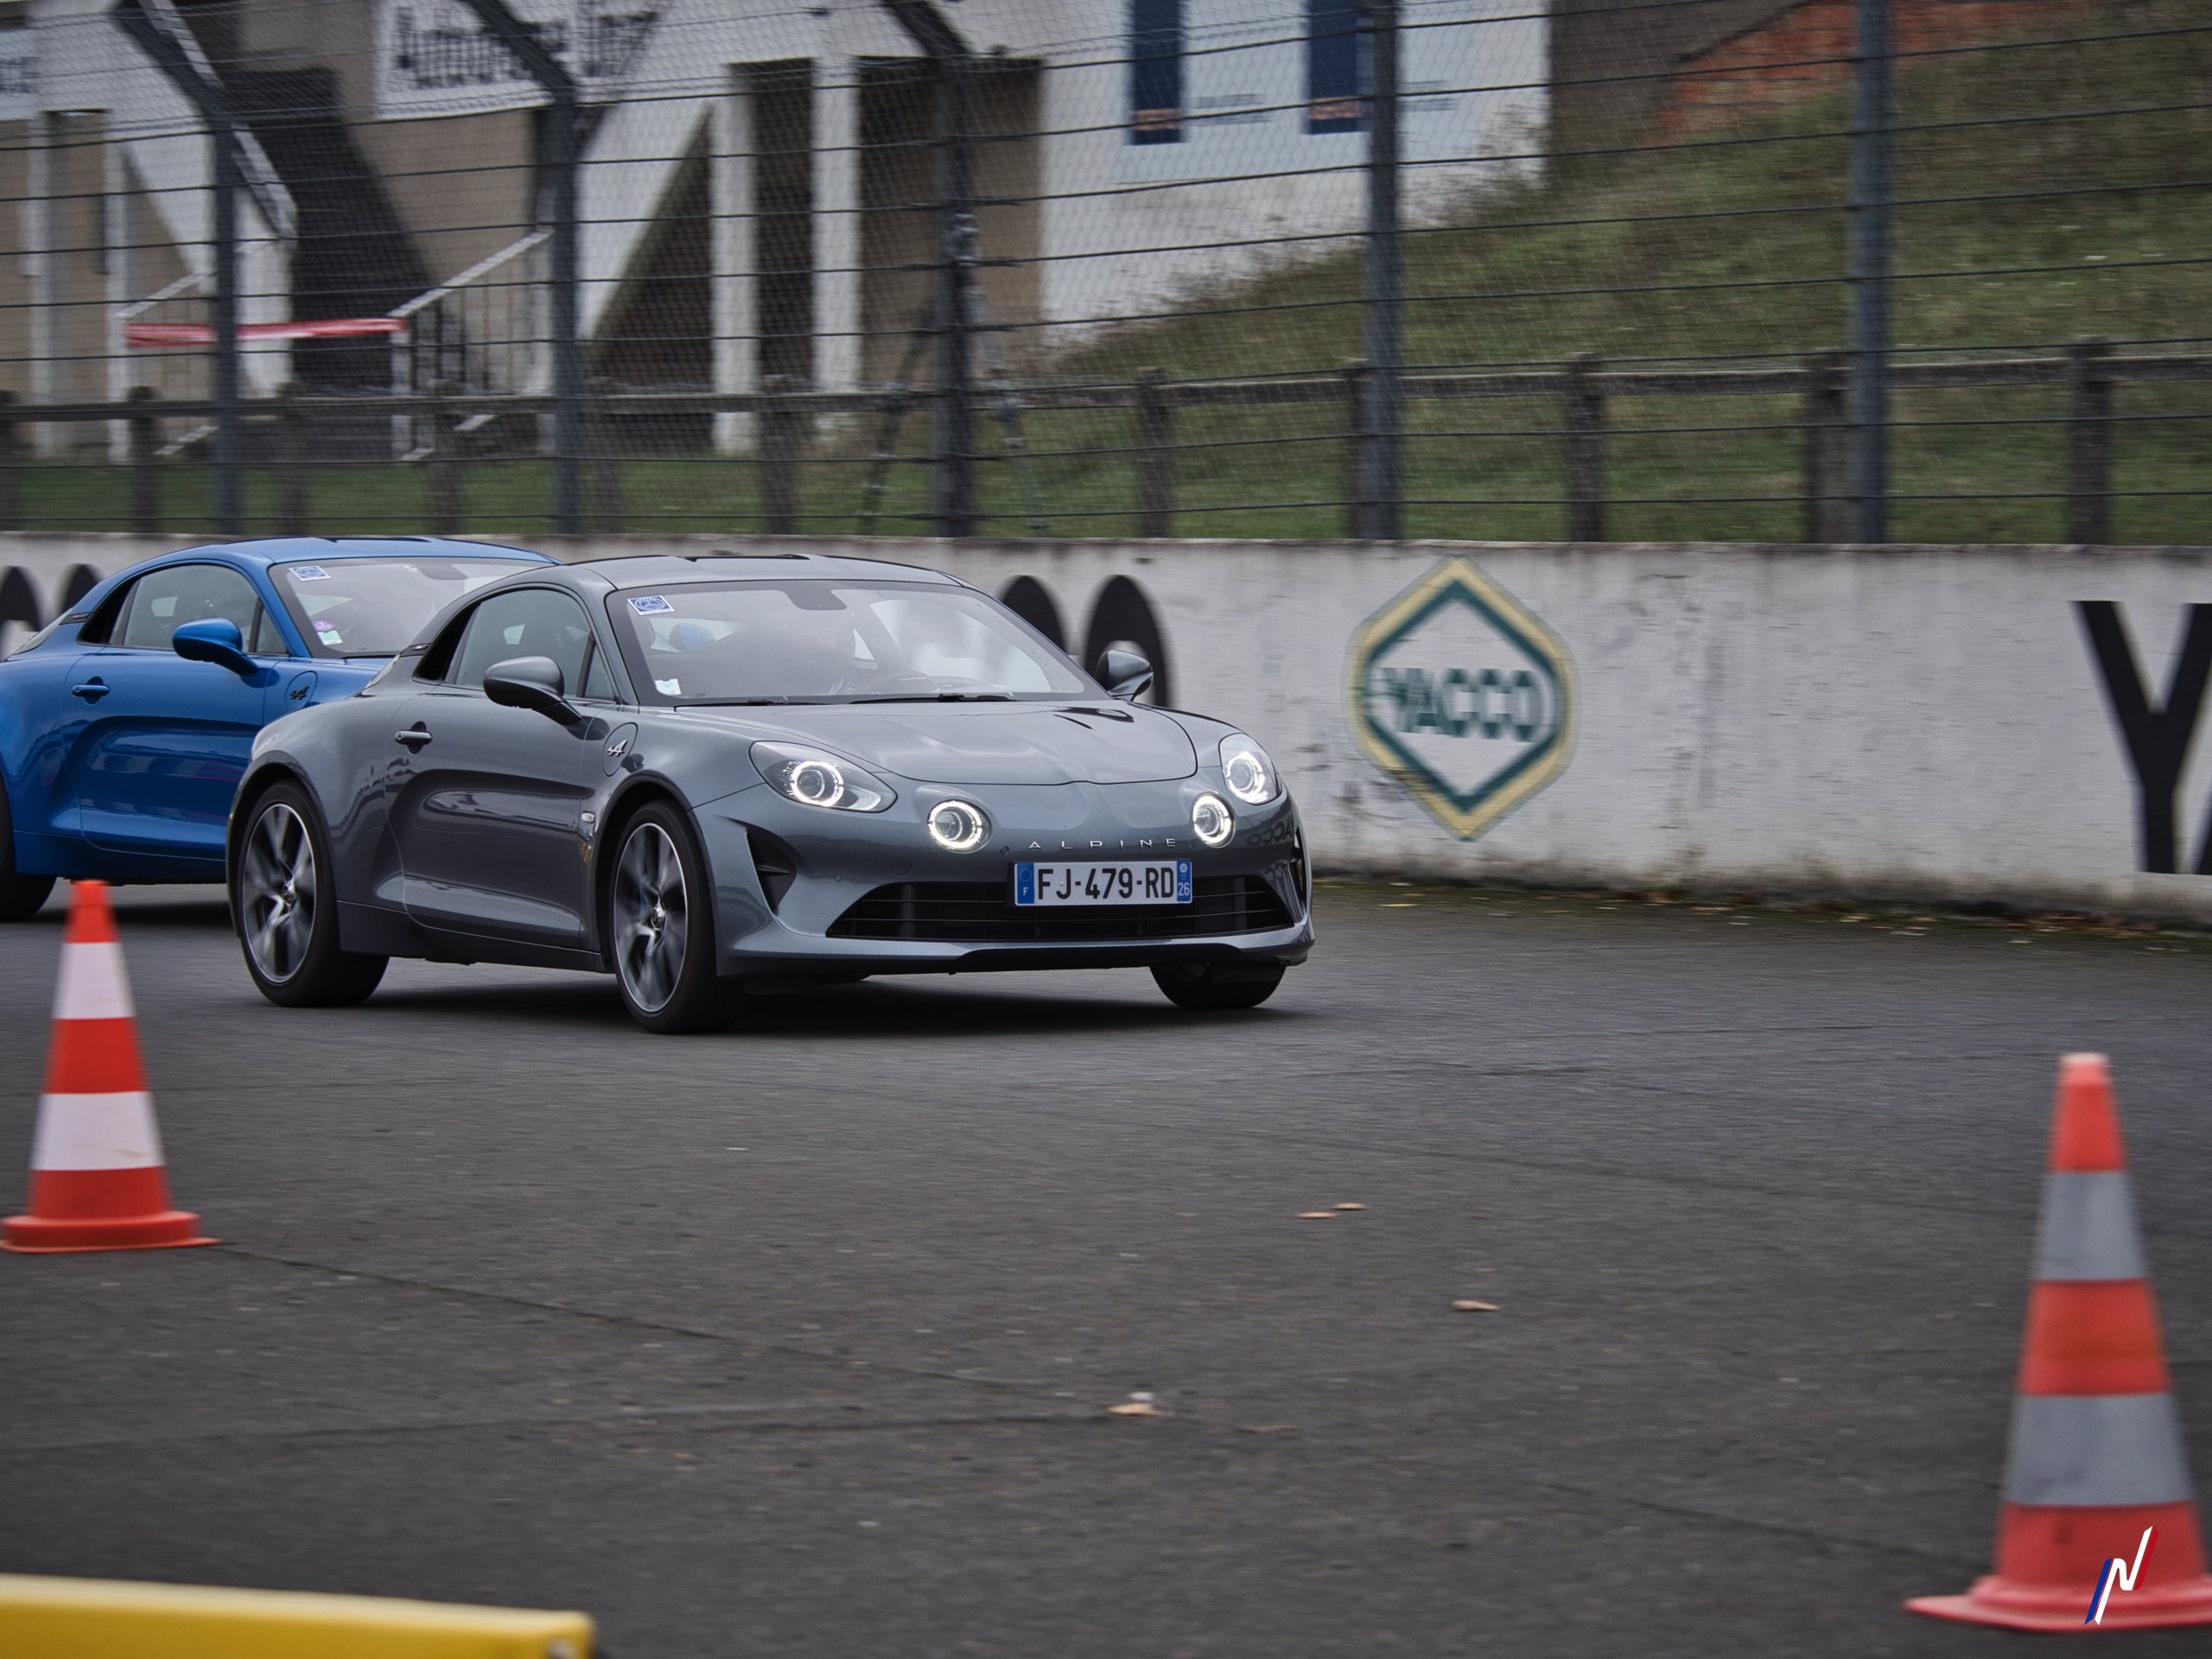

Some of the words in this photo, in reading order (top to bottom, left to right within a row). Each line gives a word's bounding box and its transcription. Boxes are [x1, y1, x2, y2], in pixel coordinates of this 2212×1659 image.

[1374, 667, 1545, 742] YACCO
[2070, 600, 2212, 875] Y
[1028, 838, 1176, 850] ALPINE
[1022, 887, 1028, 896] F
[1038, 868, 1174, 899] FJ-479-RD
[1178, 881, 1190, 897] 26
